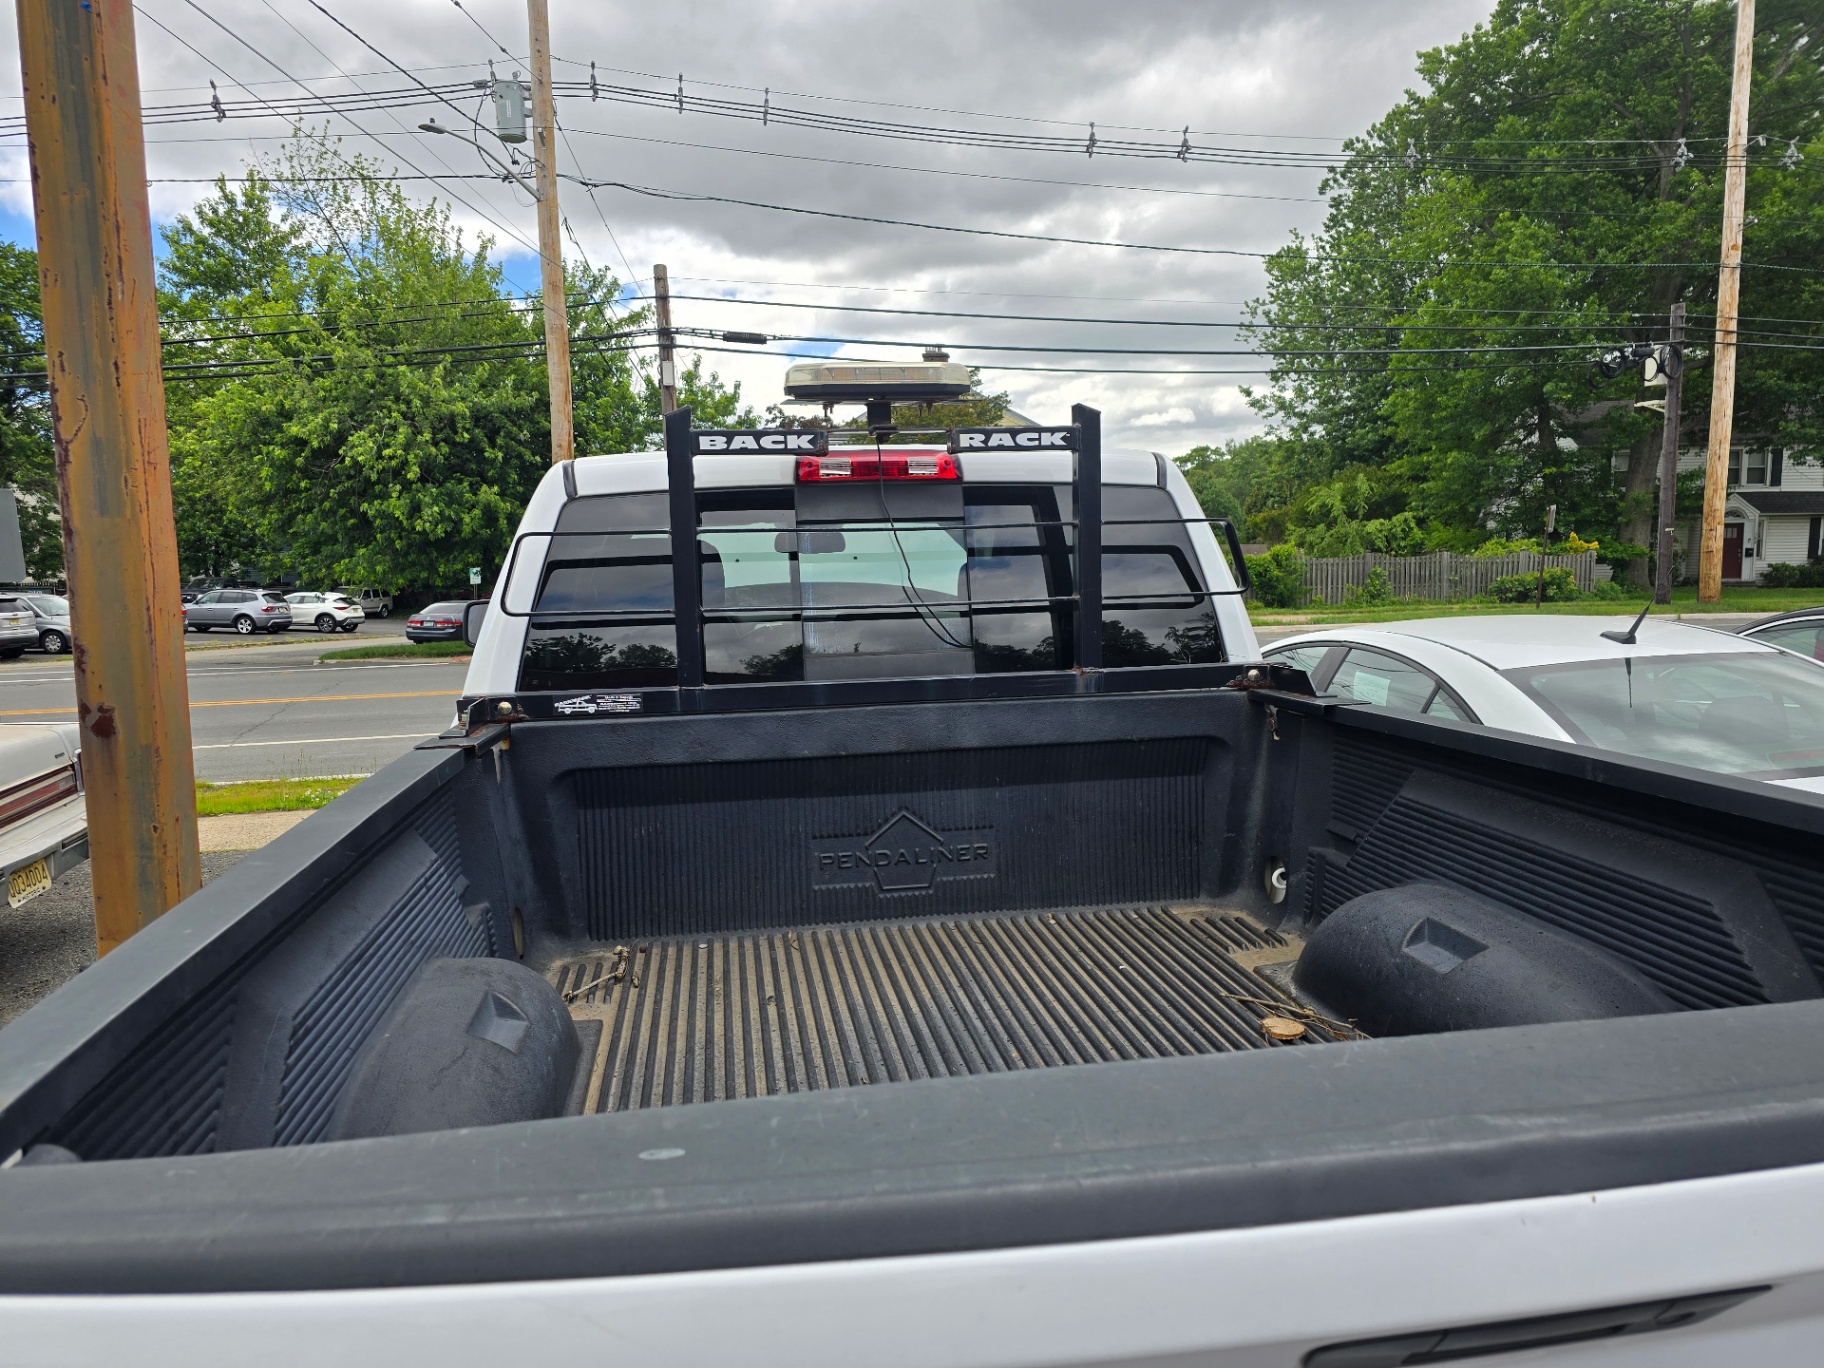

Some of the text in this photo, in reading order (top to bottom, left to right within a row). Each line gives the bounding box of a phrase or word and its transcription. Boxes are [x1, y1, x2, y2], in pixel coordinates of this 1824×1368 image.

[699, 431, 1068, 450] BACK RACK
[819, 843, 988, 870] PENDALINER
